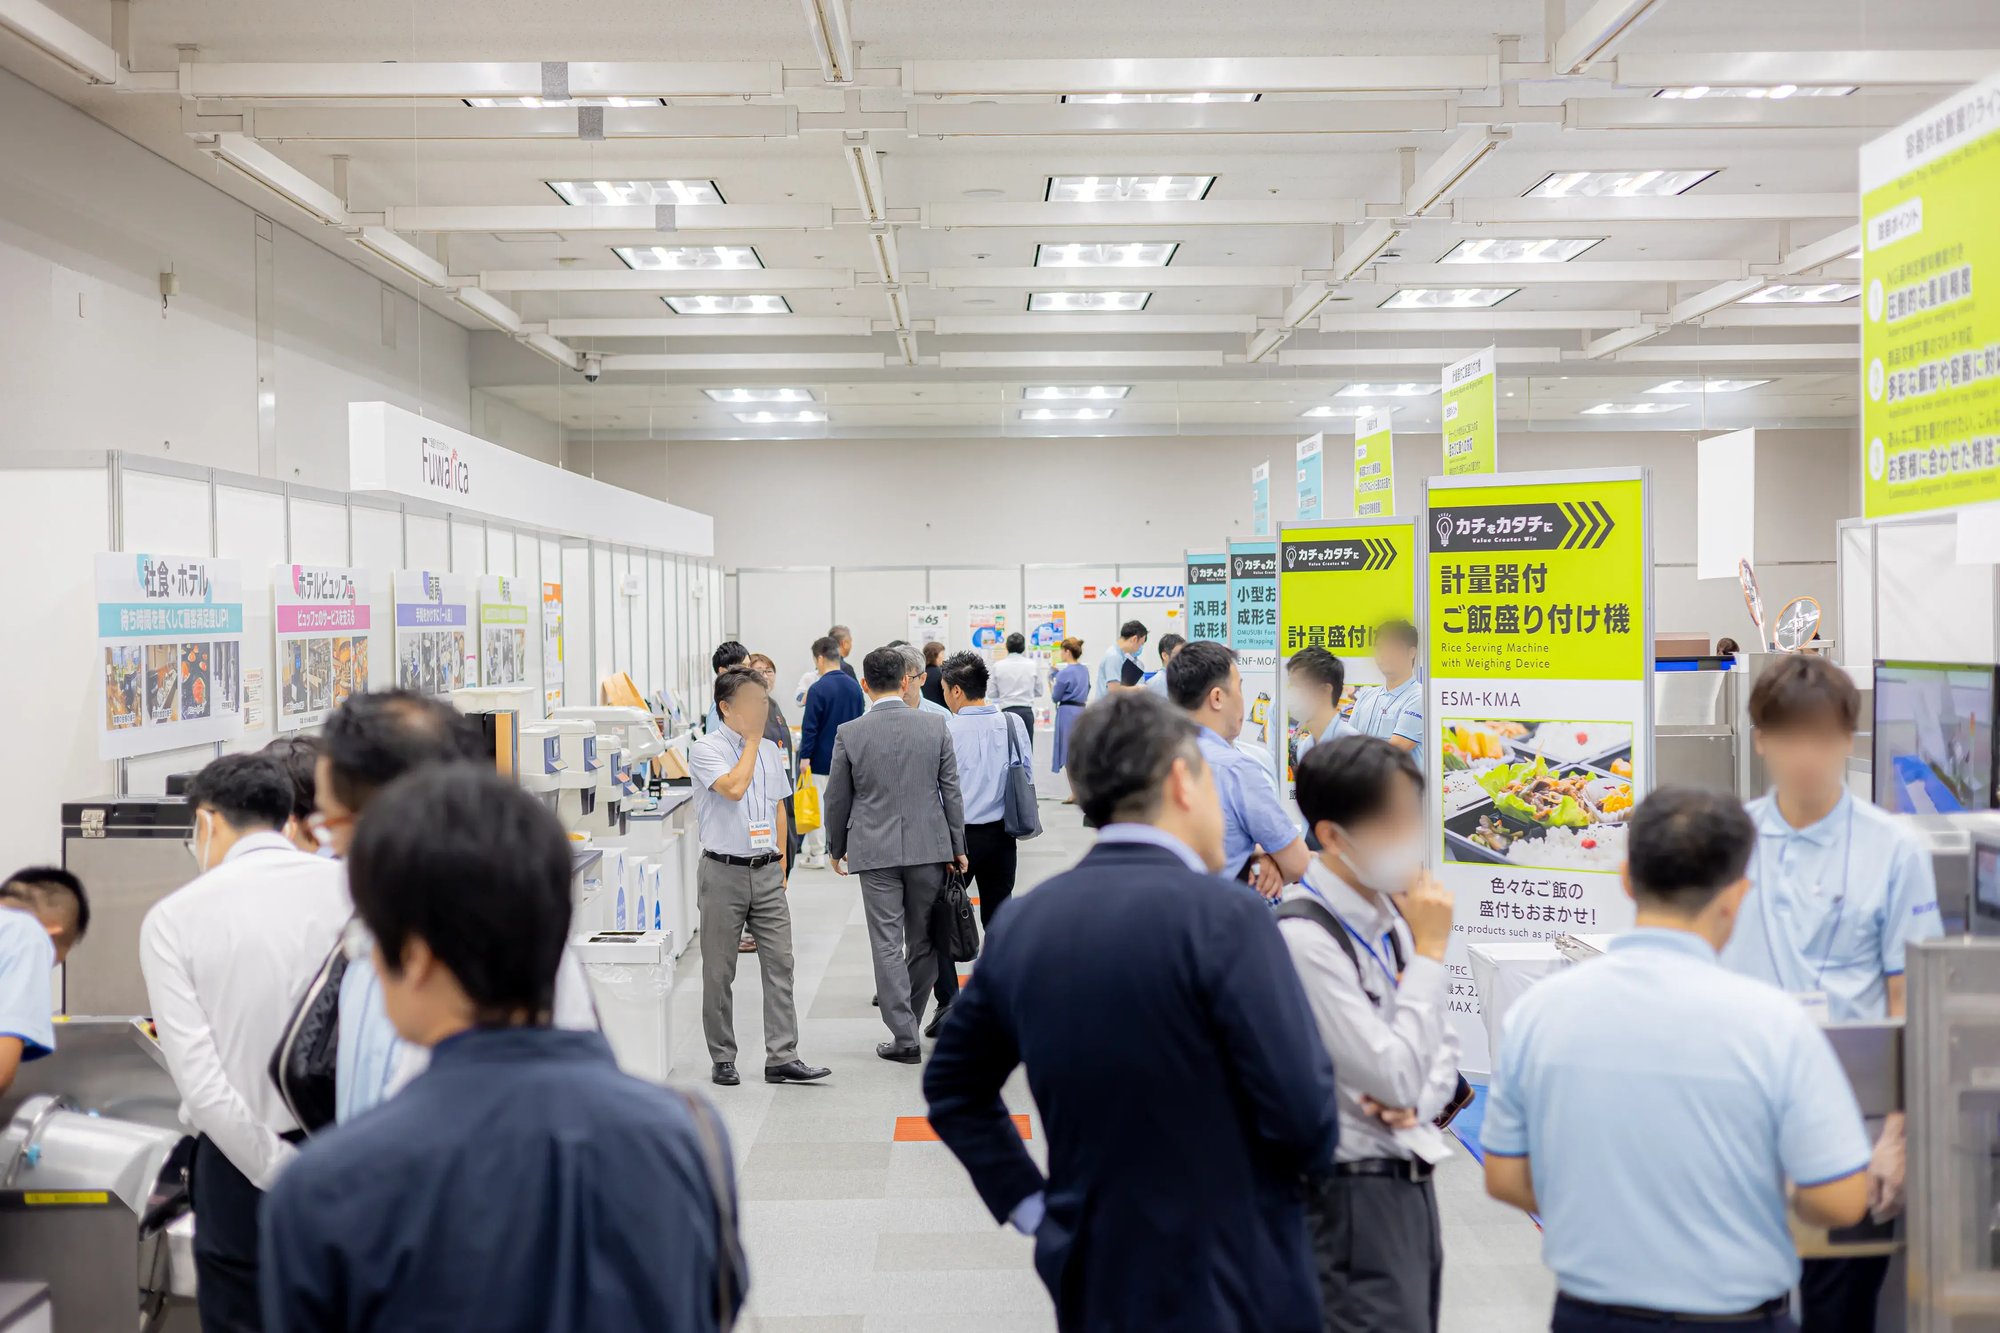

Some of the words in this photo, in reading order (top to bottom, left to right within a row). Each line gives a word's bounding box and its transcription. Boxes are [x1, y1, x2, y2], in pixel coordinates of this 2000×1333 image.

[421, 436, 469, 494] Fuwarica
[1888, 437, 2000, 483] お客様に合わせた特注
[1456, 515, 1554, 535] カチをカタチに
[1298, 547, 1360, 561] カチをカタチに
[143, 560, 209, 598] 社食・ホテル
[297, 571, 354, 599] ホテルビュッフェ
[1440, 562, 1548, 595] 計量器付
[1442, 602, 1631, 635] ご飯盛り付け機
[1441, 642, 1462, 653] Rice
[1466, 642, 1502, 656] Serving
[1506, 642, 1550, 653] Machine
[1441, 658, 1461, 668] with
[1465, 658, 1512, 671] Weighing
[1515, 658, 1550, 669] Device
[1441, 691, 1521, 707] ESM-KMA
[1490, 877, 1584, 900] 色々なご飯の
[1467, 923, 1506, 936] products
[1508, 926, 1530, 938] such
[1532, 930, 1543, 939] as
